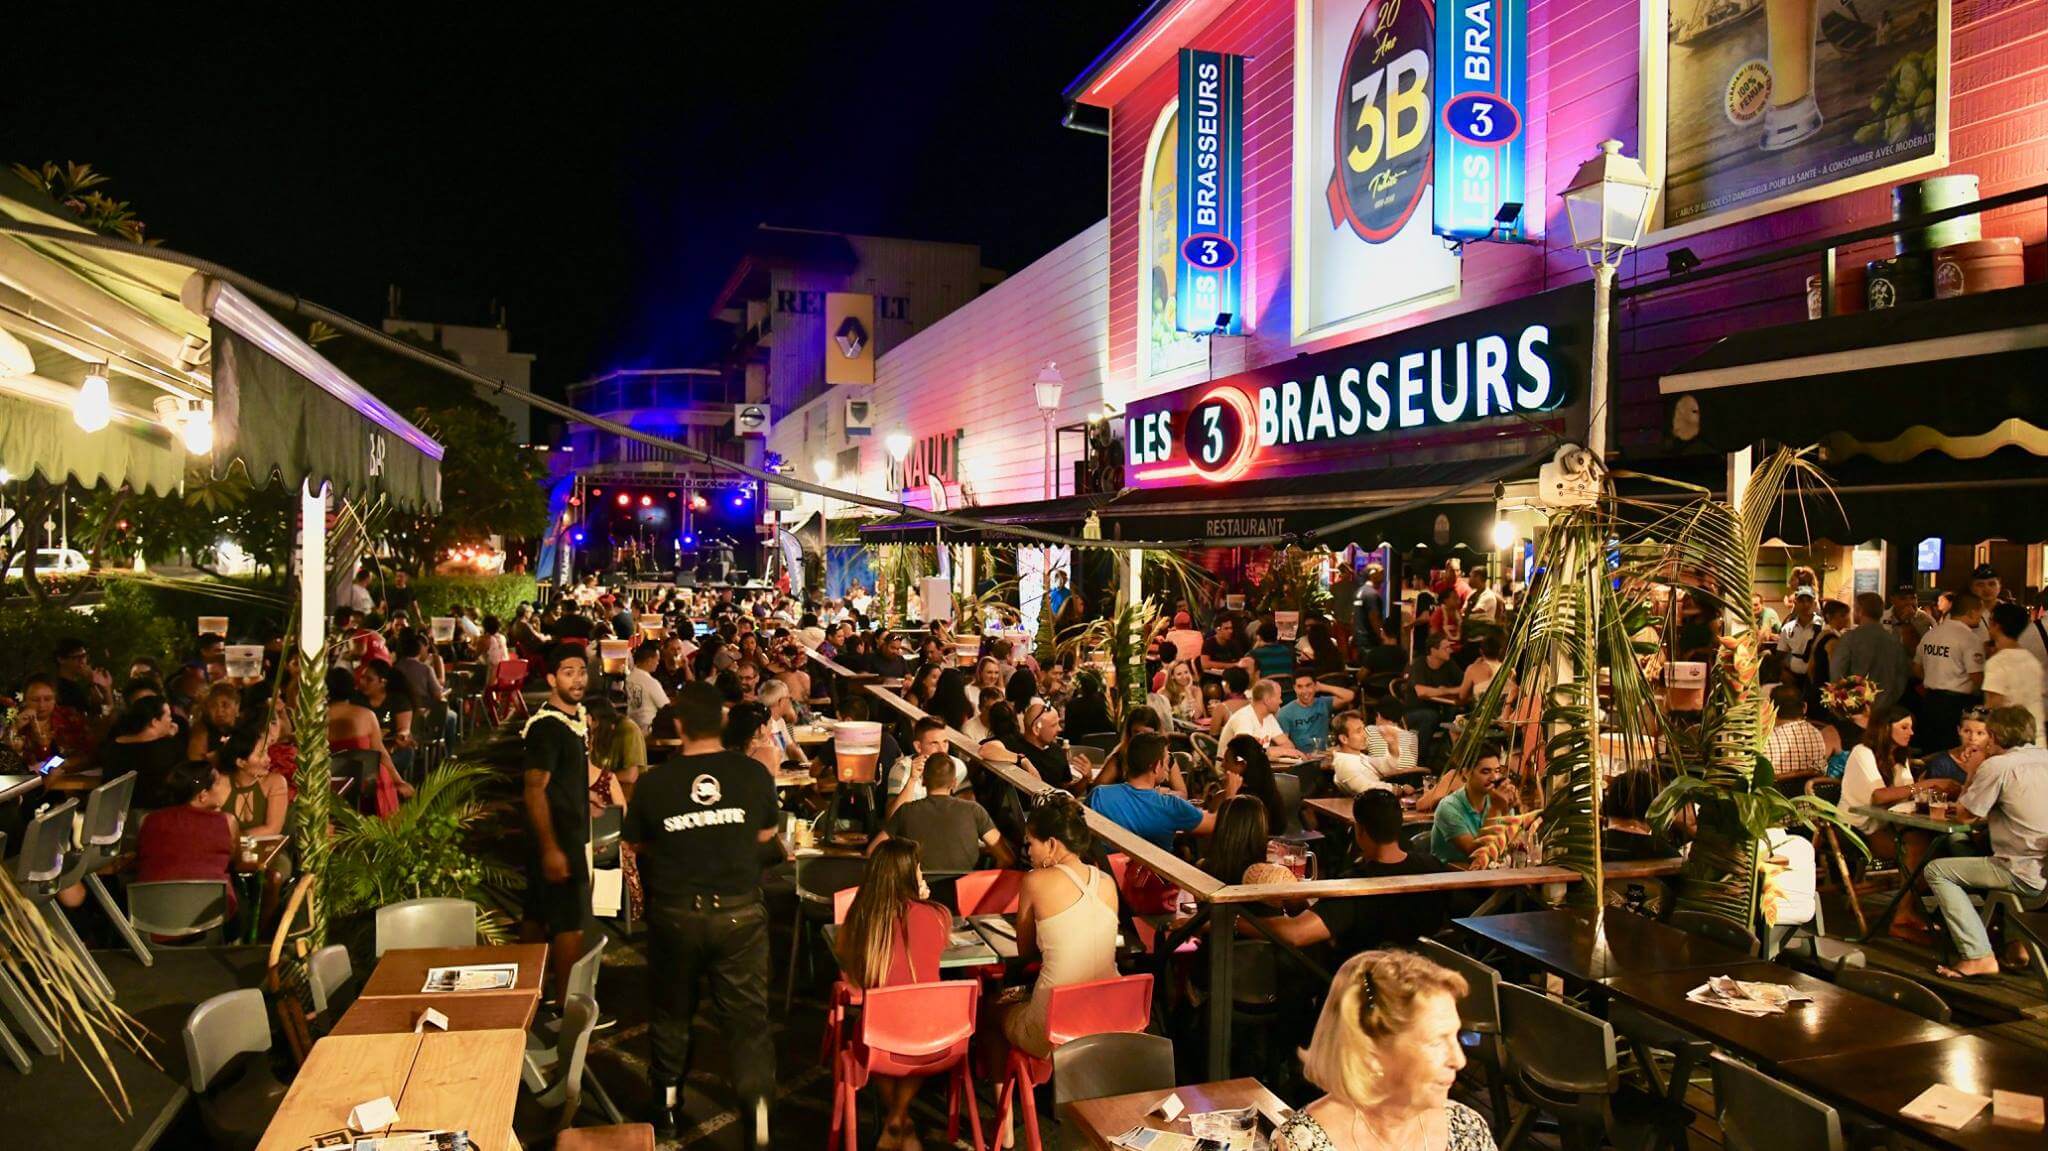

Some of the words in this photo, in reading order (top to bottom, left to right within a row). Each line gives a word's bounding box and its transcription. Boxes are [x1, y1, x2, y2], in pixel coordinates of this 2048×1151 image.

[1464, 1, 1490, 81] BRA
[1738, 76, 1757, 97] 100%
[1740, 81, 1764, 109] FENUA
[1347, 49, 1430, 172] 3B
[1469, 102, 1493, 136] 3
[1197, 64, 1218, 225] BRASSEURS
[1462, 154, 1489, 226] LES
[1768, 178, 1786, 190] POUR
[1788, 175, 1796, 185] LA
[1829, 151, 1874, 173] CONSOMMER
[1875, 145, 1894, 160] AVEC
[1200, 240, 1218, 265] 3
[1196, 276, 1216, 324] LES
[1130, 410, 1172, 465] LES
[1202, 405, 1224, 463] 3
[1258, 325, 1551, 448] BRASSEURS
[1206, 517, 1285, 537] RESTAURANT
[1923, 644, 1950, 658] POLICE
